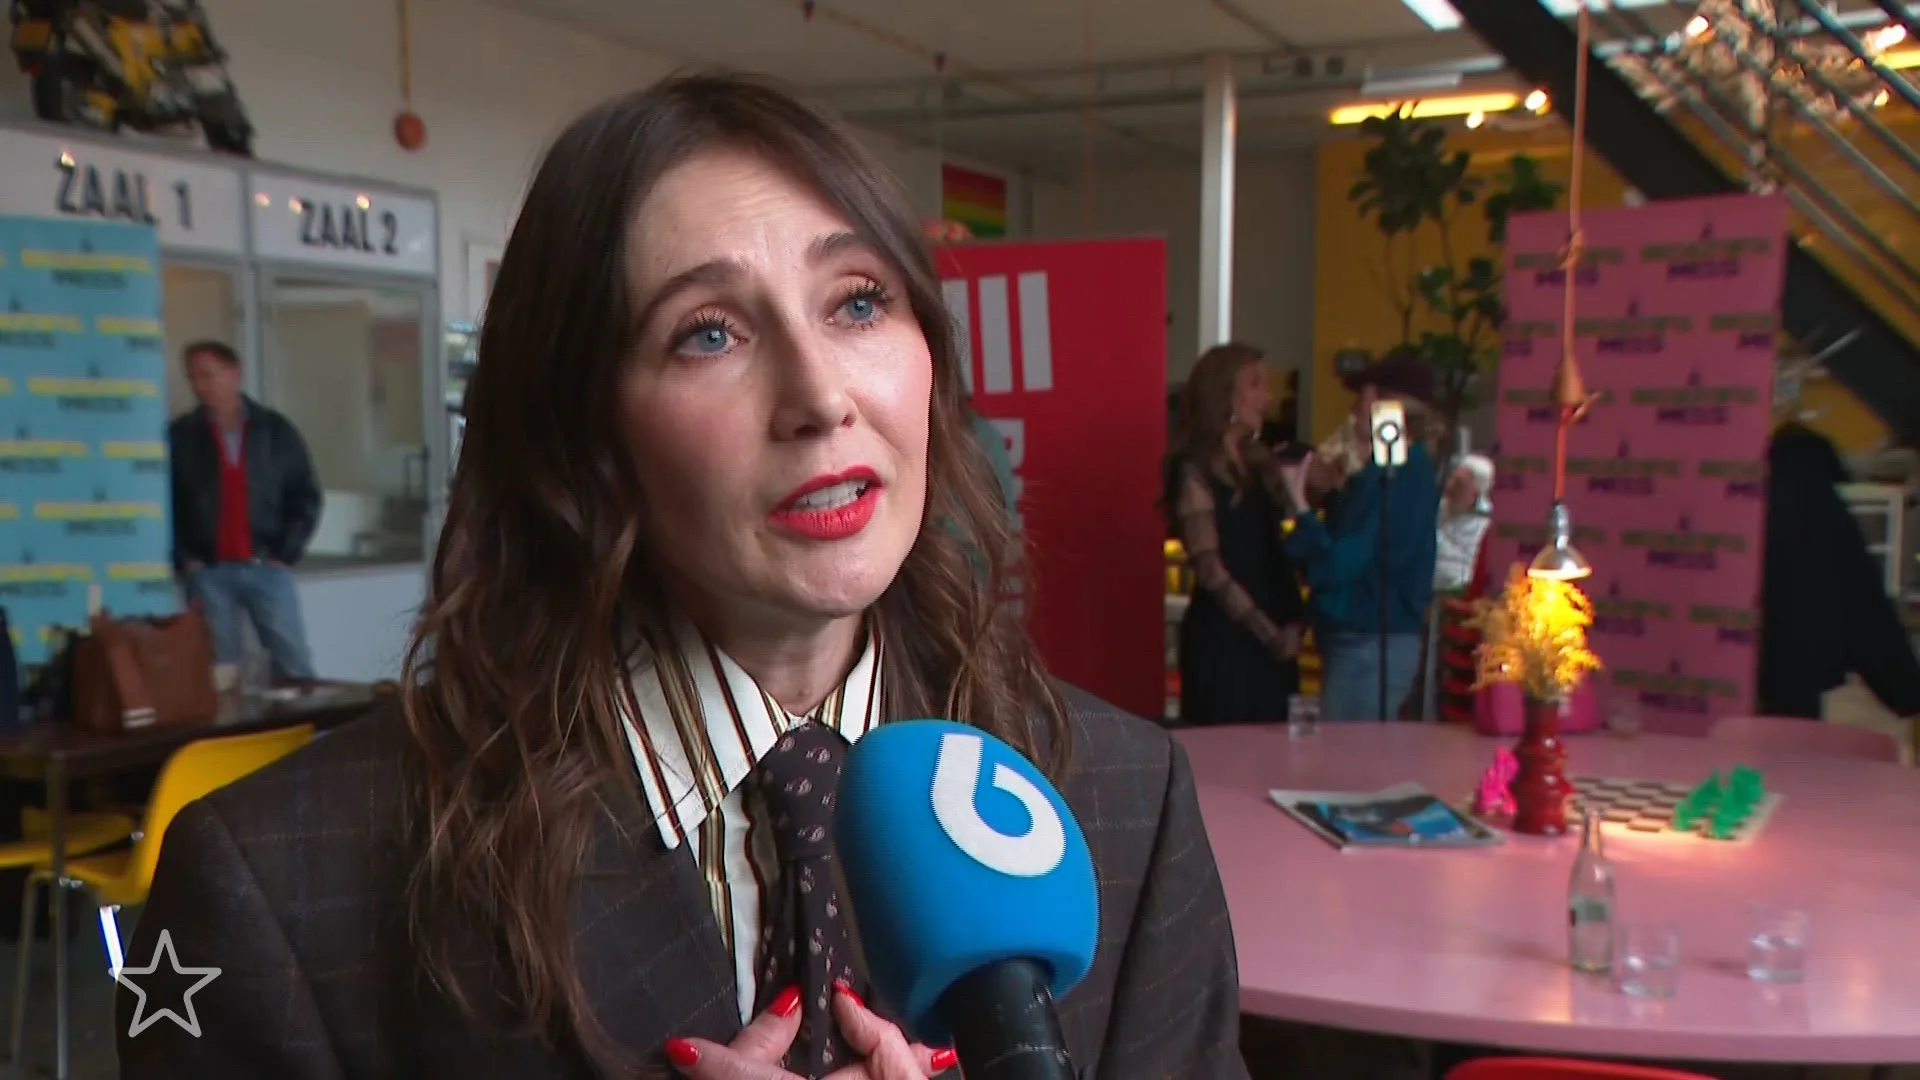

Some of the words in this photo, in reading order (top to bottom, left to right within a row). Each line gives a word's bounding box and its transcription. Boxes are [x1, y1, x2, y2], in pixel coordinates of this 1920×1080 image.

[54, 158, 158, 227] ZAAL
[172, 179, 194, 232] 1
[300, 198, 376, 252] ZAAL
[379, 207, 399, 255] 2
[931, 733, 1066, 878] 6
